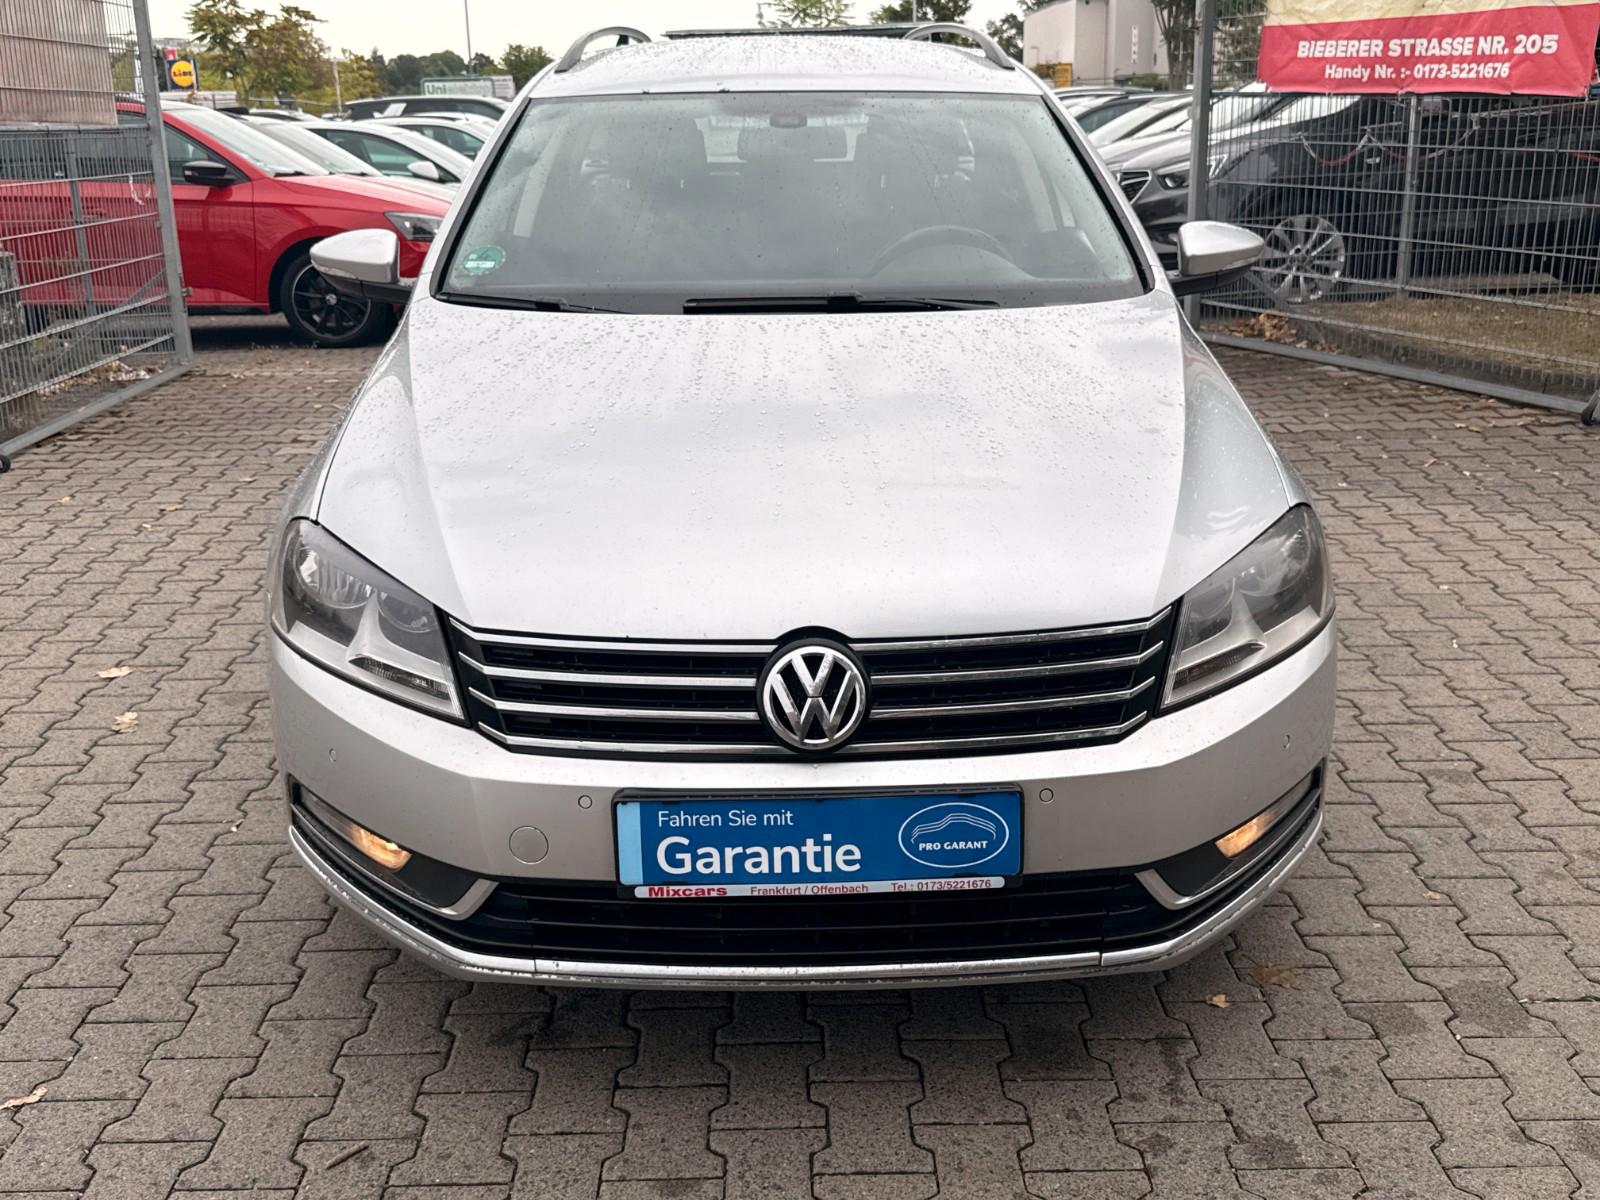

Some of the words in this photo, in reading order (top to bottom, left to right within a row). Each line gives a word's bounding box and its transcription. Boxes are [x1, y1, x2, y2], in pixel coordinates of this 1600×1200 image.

[1297, 39, 1384, 58] BIEBERER
[1387, 37, 1474, 57] STRASSE
[1477, 35, 1509, 55] NR.
[1513, 34, 1559, 54] 205
[1325, 64, 1370, 82] Handy
[1374, 64, 1396, 79] Nr.
[1413, 62, 1511, 79] 0173-5221676
[764, 646, 865, 749] VW
[658, 810, 722, 828] Fahren
[728, 809, 757, 826] Sie
[763, 809, 794, 826] mit
[656, 833, 862, 875] Garantie
[918, 842, 941, 851] PRO
[943, 840, 988, 850] GARANT
[648, 886, 728, 897] Mixcars
[750, 886, 802, 896] Frankfurt
[811, 883, 869, 895] Offenbach
[891, 882, 914, 892] Tel.:
[916, 879, 992, 891] 0173/5221676
